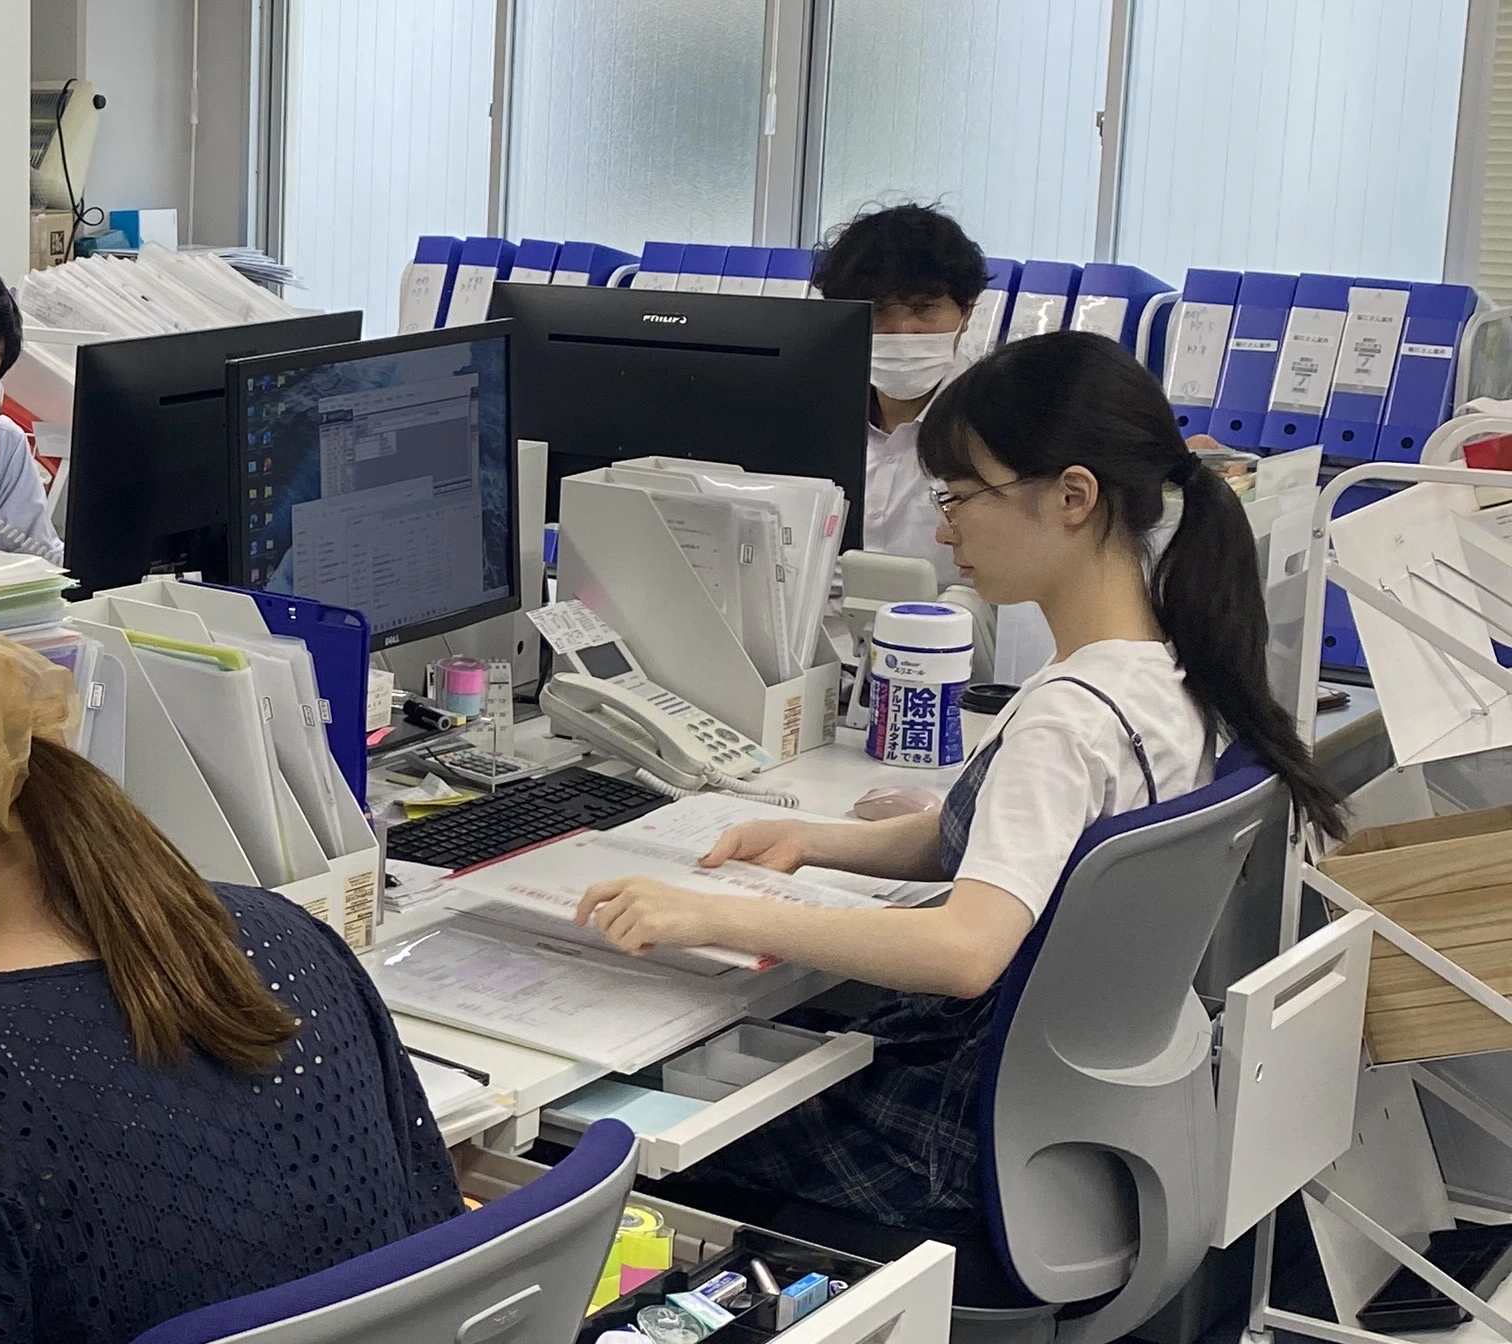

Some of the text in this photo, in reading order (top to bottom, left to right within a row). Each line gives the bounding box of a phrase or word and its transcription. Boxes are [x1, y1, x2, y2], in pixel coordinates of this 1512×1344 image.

[886, 685, 902, 761] アルコールタオル
[901, 687, 937, 752] 除菌
[901, 753, 933, 764] できる
